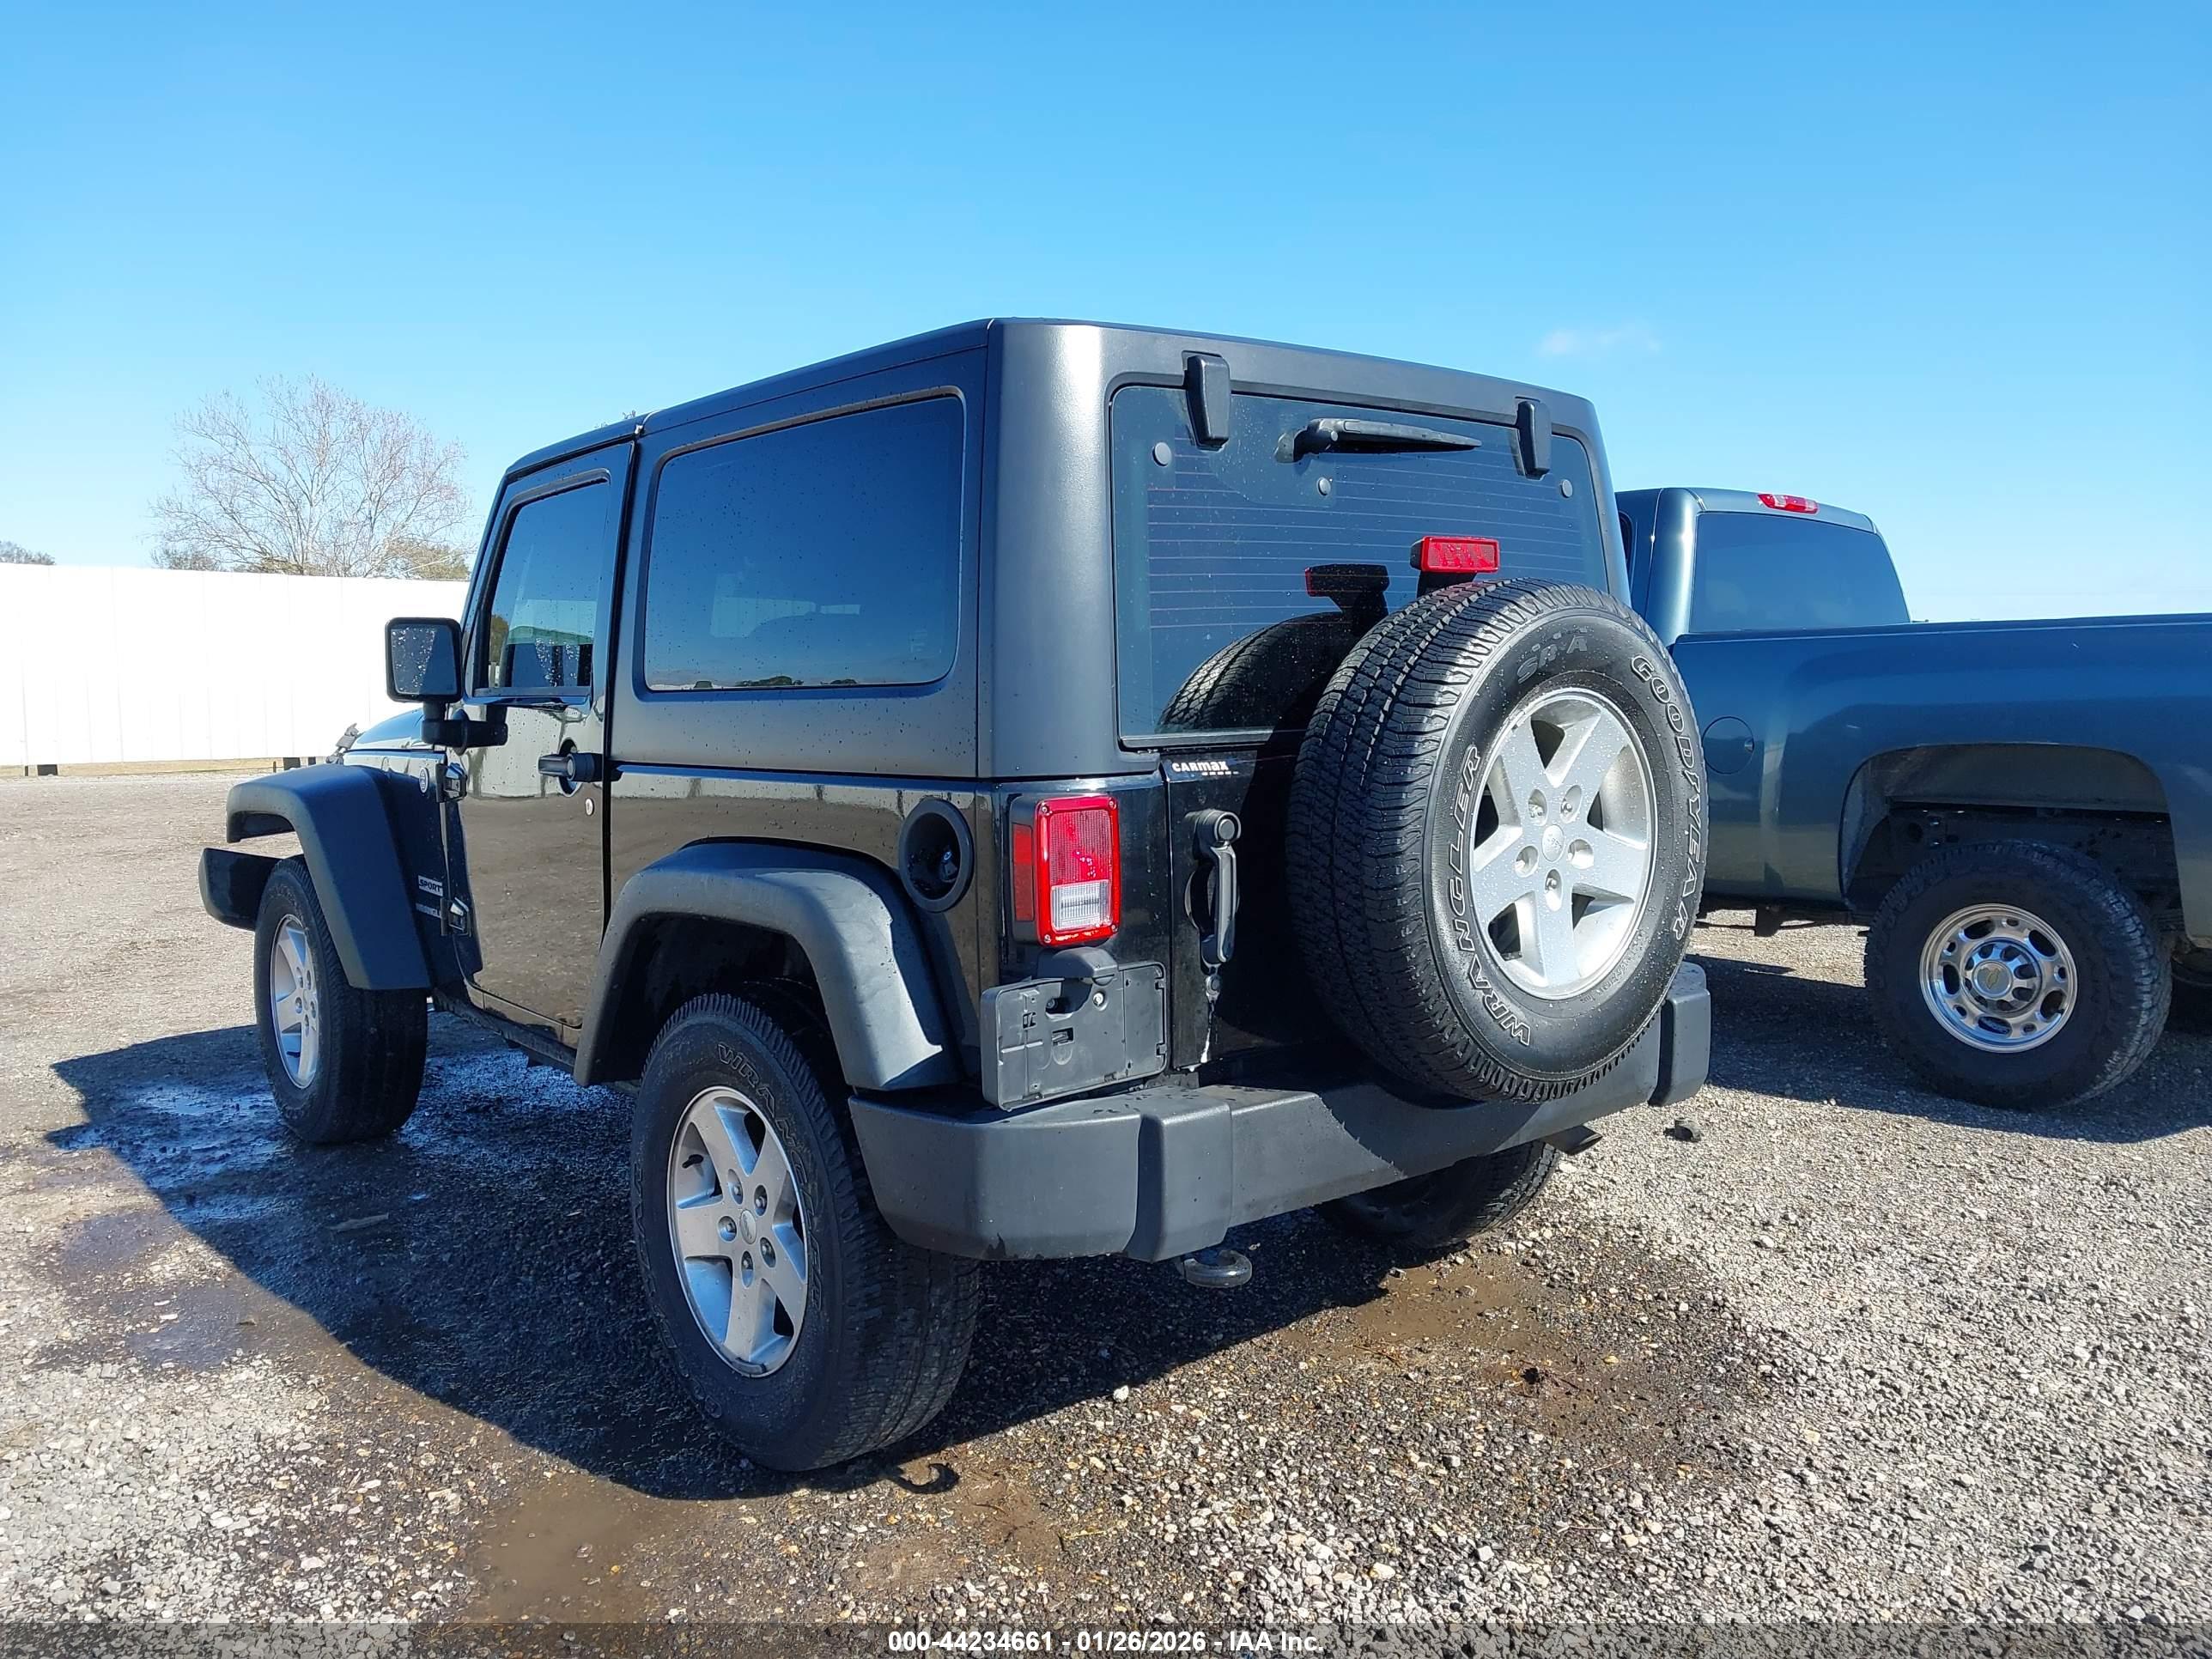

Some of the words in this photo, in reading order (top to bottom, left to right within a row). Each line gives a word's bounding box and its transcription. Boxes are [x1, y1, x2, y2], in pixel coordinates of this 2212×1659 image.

[419, 879, 442, 892] SPORT
[1448, 744, 1531, 1048] WRANGLER
[1630, 654, 1703, 942] GOODYEAR
